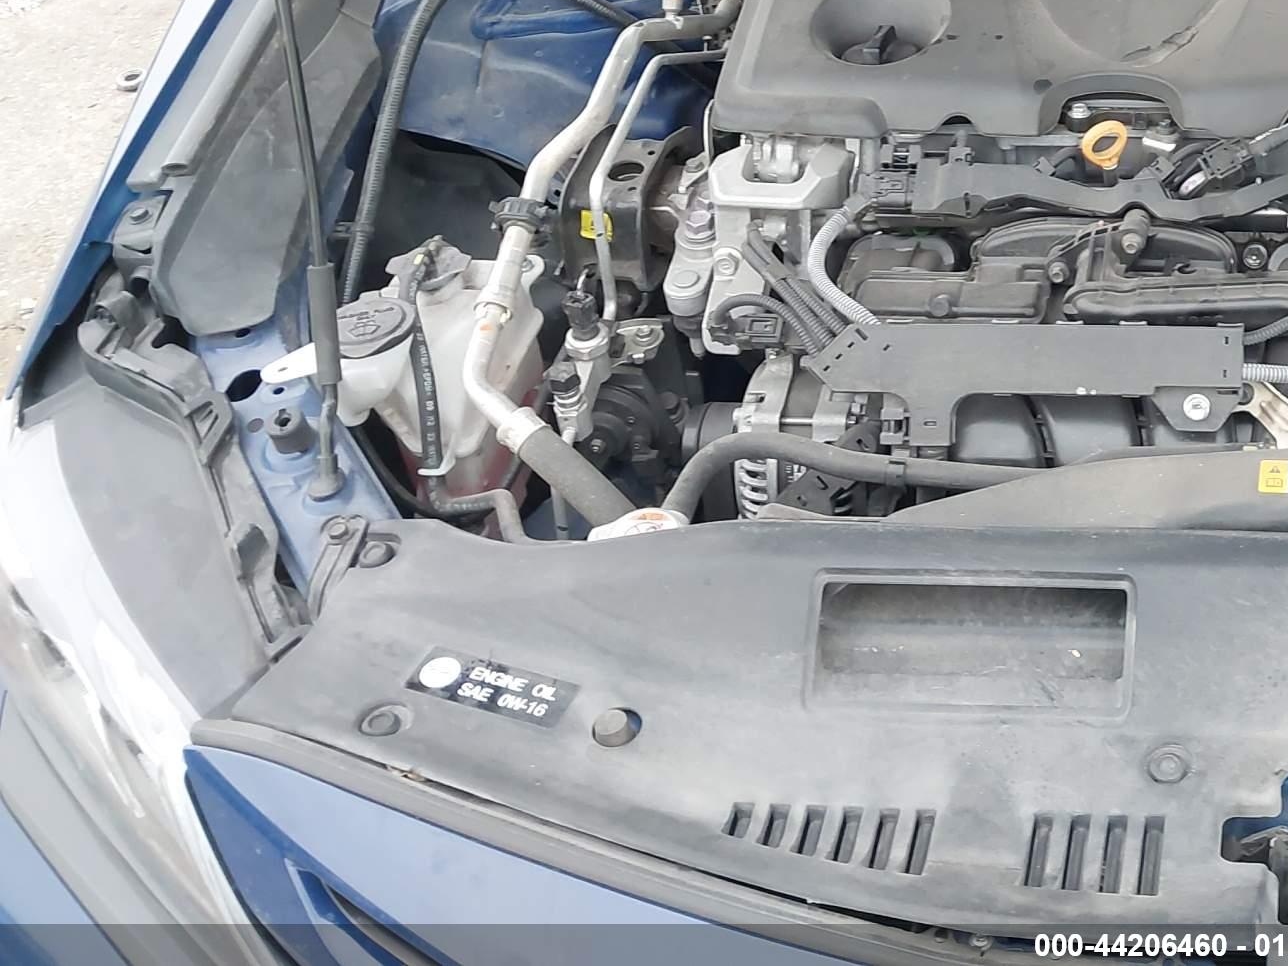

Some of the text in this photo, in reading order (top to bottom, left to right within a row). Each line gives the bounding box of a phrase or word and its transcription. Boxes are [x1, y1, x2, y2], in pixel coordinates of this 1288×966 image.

[457, 682, 548, 717] SAE 0W-16
[469, 666, 557, 701] ENGINE OIL
